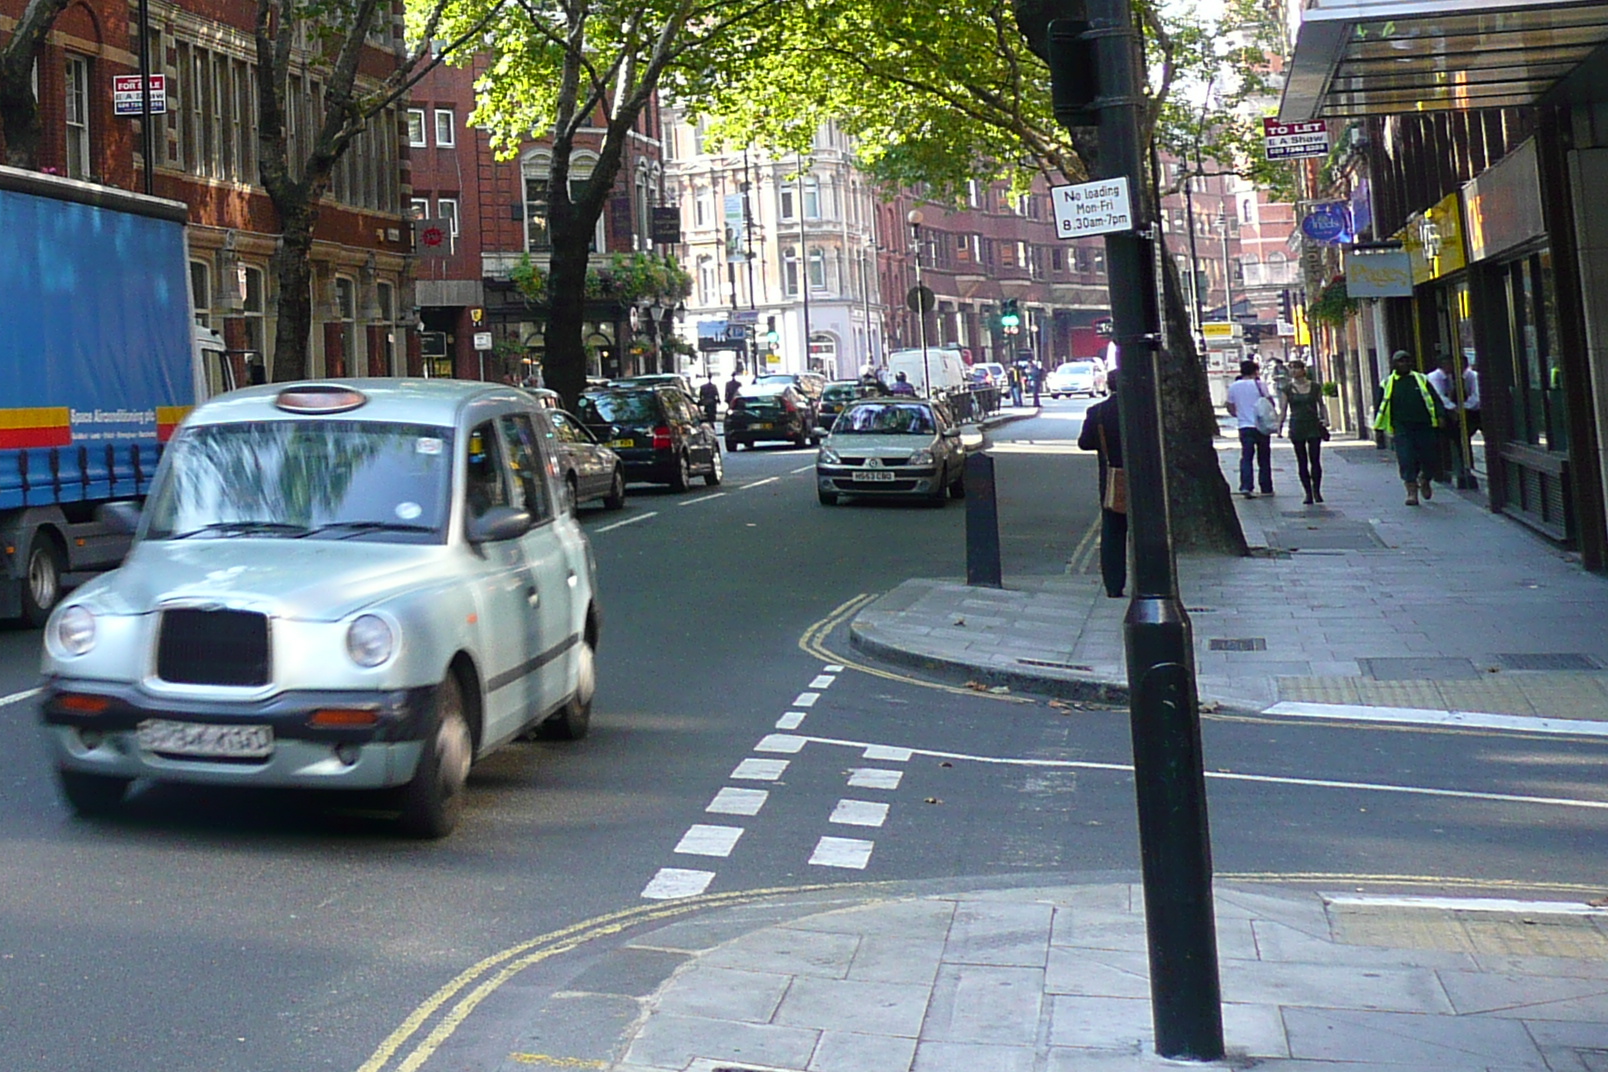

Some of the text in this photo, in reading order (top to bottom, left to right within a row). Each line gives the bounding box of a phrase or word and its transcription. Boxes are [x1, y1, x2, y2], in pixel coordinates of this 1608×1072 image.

[118, 82, 136, 90] FOR
[1268, 123, 1322, 135] TO LET
[1280, 137, 1288, 145] A
[1291, 135, 1323, 144] Shaw
[1064, 185, 1120, 202] No loading
[1076, 199, 1113, 214] Mon-Fri
[1063, 213, 1127, 231] 8.30am-7pm
[71, 408, 156, 426] Space Airconditioning plc
